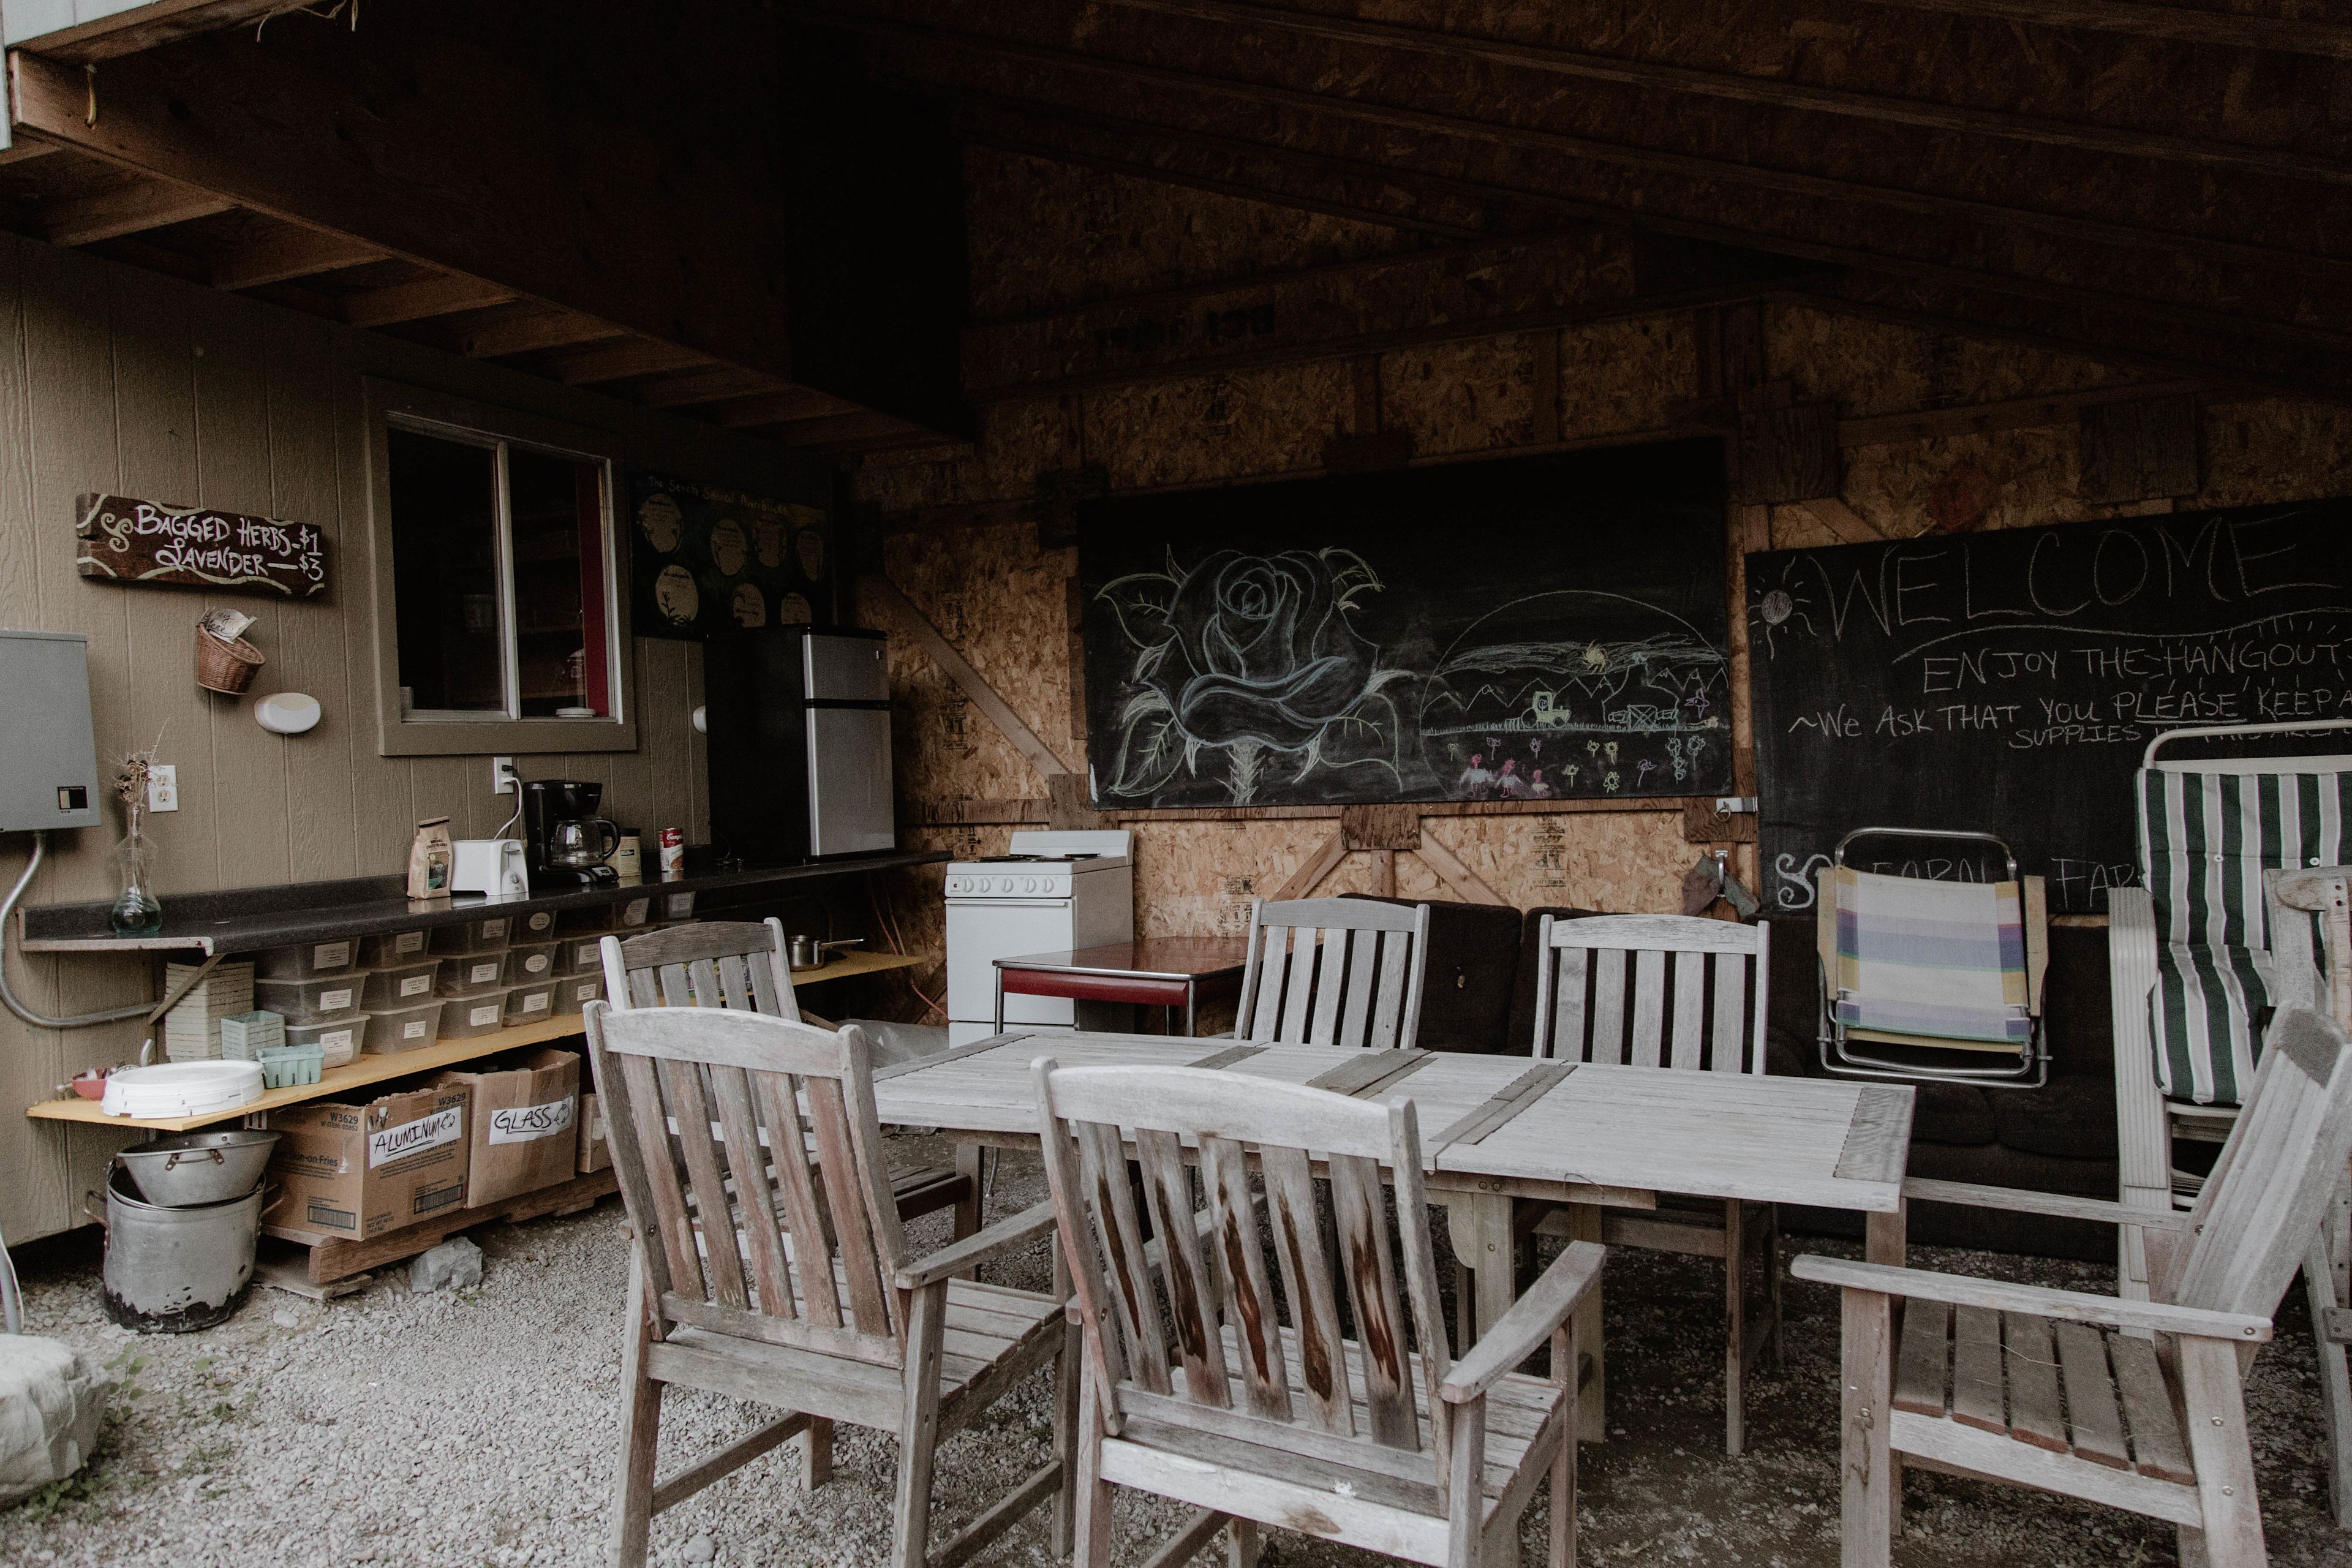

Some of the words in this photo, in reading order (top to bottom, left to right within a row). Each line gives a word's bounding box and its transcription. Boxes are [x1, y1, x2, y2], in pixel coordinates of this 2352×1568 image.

[134, 505, 230, 543] BAGGED
[237, 518, 291, 557] HERBS
[156, 537, 268, 576] LAVENDER
[1807, 509, 2343, 641] WELCOME
[1924, 647, 2057, 693] ENJOY
[2070, 646, 2149, 679] THE
[2163, 640, 2341, 676] HANGOUT
[1937, 704, 2021, 731] THAT
[2040, 698, 2103, 725] YOU
[2110, 691, 2239, 720] PLEASE
[2257, 685, 2333, 722] KEEP
[2008, 725, 2142, 749] SUPPLIES
[439, 1092, 466, 1106] W3629
[330, 1112, 359, 1125] W3629
[374, 1117, 440, 1154] ALUMINUM
[494, 1107, 551, 1134] GLASS
[319, 1155, 337, 1167] Fries
